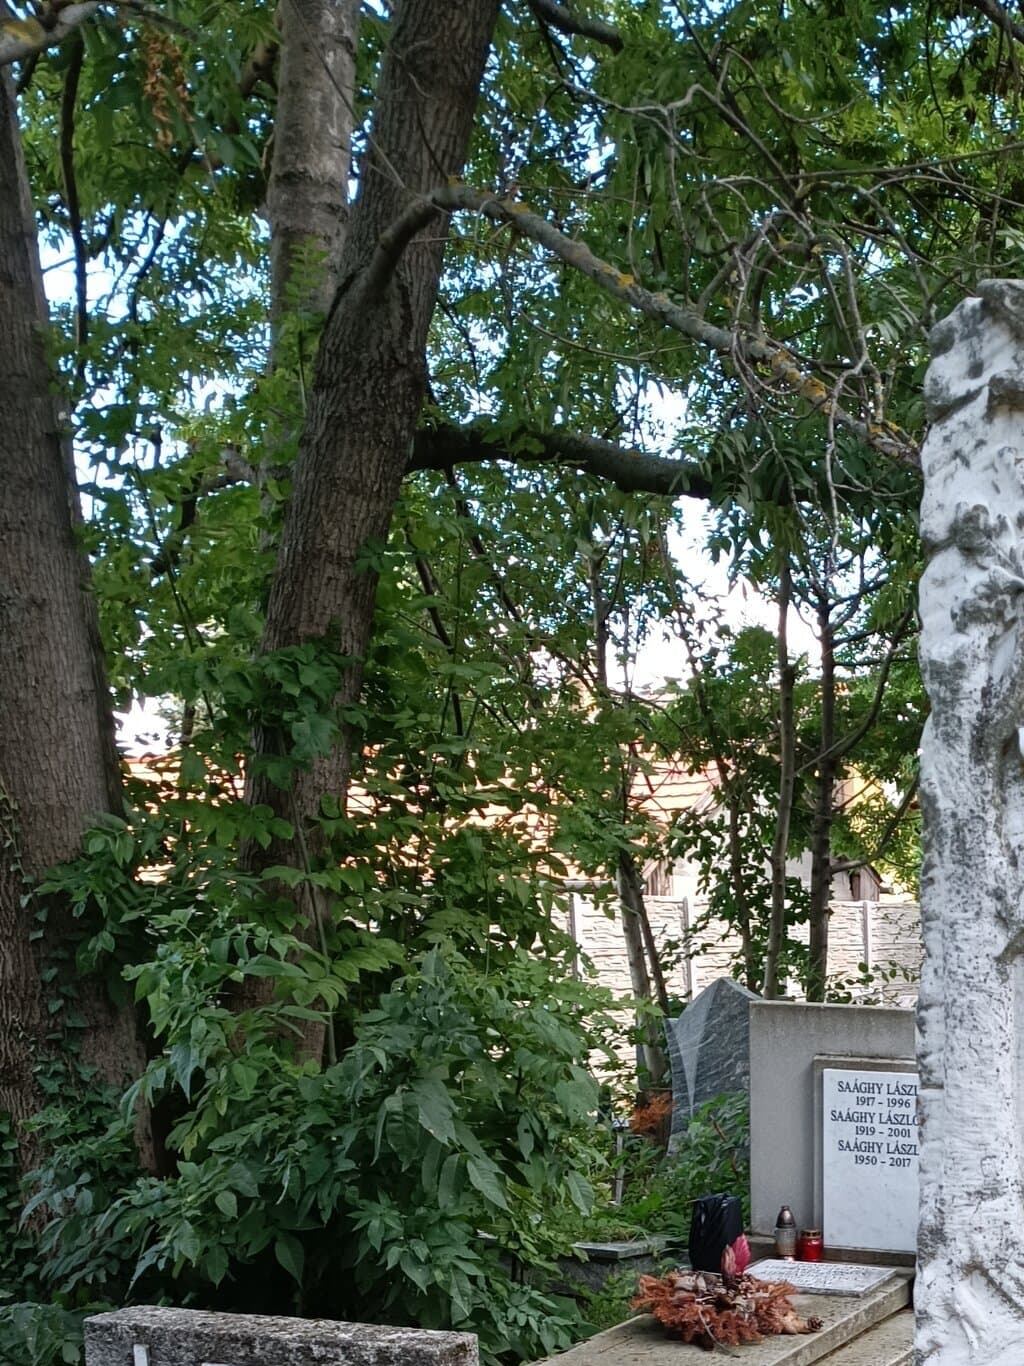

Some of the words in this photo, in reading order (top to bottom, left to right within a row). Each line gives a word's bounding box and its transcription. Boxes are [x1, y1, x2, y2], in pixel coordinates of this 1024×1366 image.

[838, 1078, 883, 1095] SAÁGHY
[887, 1081, 919, 1097] LÁSZL
[856, 1096, 875, 1106] 1917
[887, 1098, 911, 1108] 1996
[831, 1107, 876, 1124] SAÁGHY
[856, 1125, 876, 1136] 1919
[888, 1128, 911, 1138] 2001
[838, 1138, 884, 1154] SAÁGHY
[887, 1140, 920, 1156] LÁSZL
[855, 1155, 877, 1166] 1950
[889, 1157, 911, 1167] 2017
